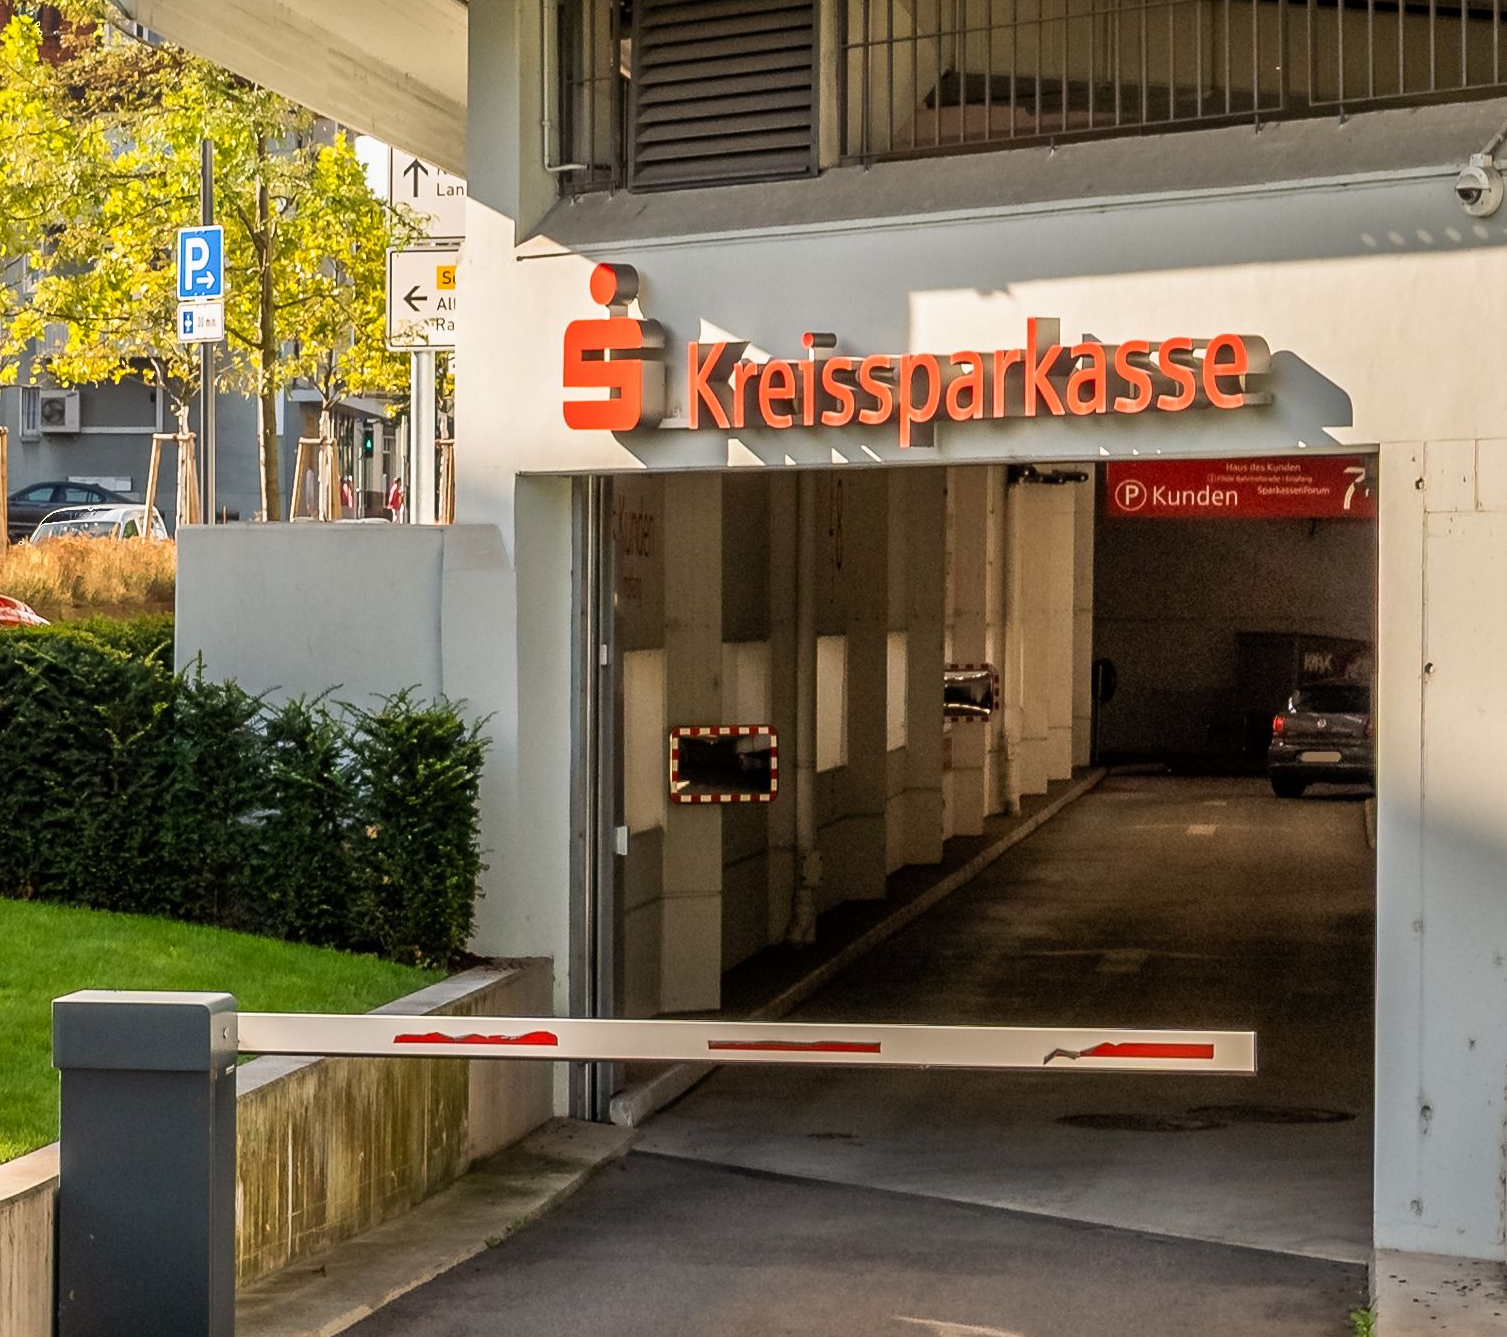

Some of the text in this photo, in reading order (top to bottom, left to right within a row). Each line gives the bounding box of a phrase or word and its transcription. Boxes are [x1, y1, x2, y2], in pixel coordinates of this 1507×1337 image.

[185, 237, 211, 291] P
[687, 316, 1255, 449] Kreissparkasse
[1226, 463, 1301, 473] Haus des Kunden
[1125, 485, 1238, 506] P Kunden
